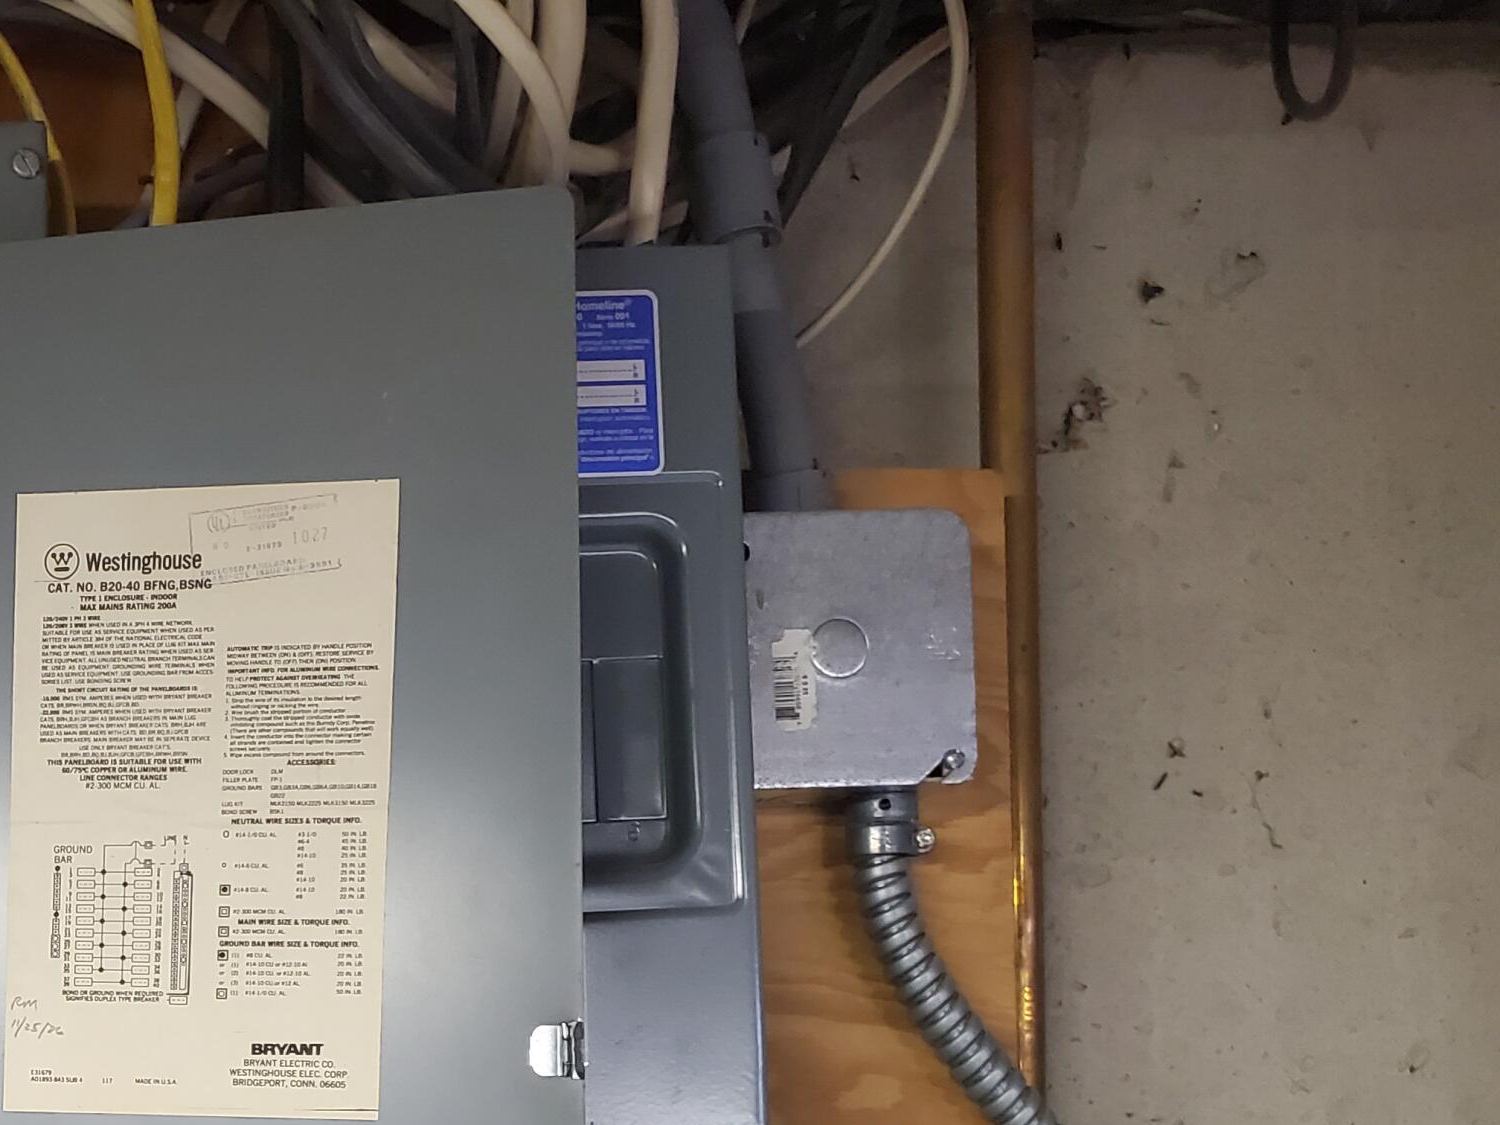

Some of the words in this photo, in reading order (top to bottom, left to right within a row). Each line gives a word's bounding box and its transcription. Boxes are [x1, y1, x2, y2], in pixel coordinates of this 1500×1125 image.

[86, 552, 202, 574] Westinghouse
[48, 582, 72, 593] CAT.
[77, 582, 96, 592] NO.
[100, 581, 140, 592] B20-40
[144, 579, 212, 591] BFNG,BSNG
[54, 845, 92, 854] GROUND
[251, 1043, 323, 1056] BRYANT
[243, 1059, 277, 1067] BRYANT
[280, 1059, 319, 1068] ELECTRIC
[322, 1060, 334, 1068] CO.
[229, 1068, 297, 1077] WESTINGHOUSE
[299, 1069, 321, 1077] ELEC.
[232, 1078, 288, 1089] BRIDGEPORT,
[290, 1079, 317, 1088] CONN.
[320, 1080, 346, 1089] 06605
